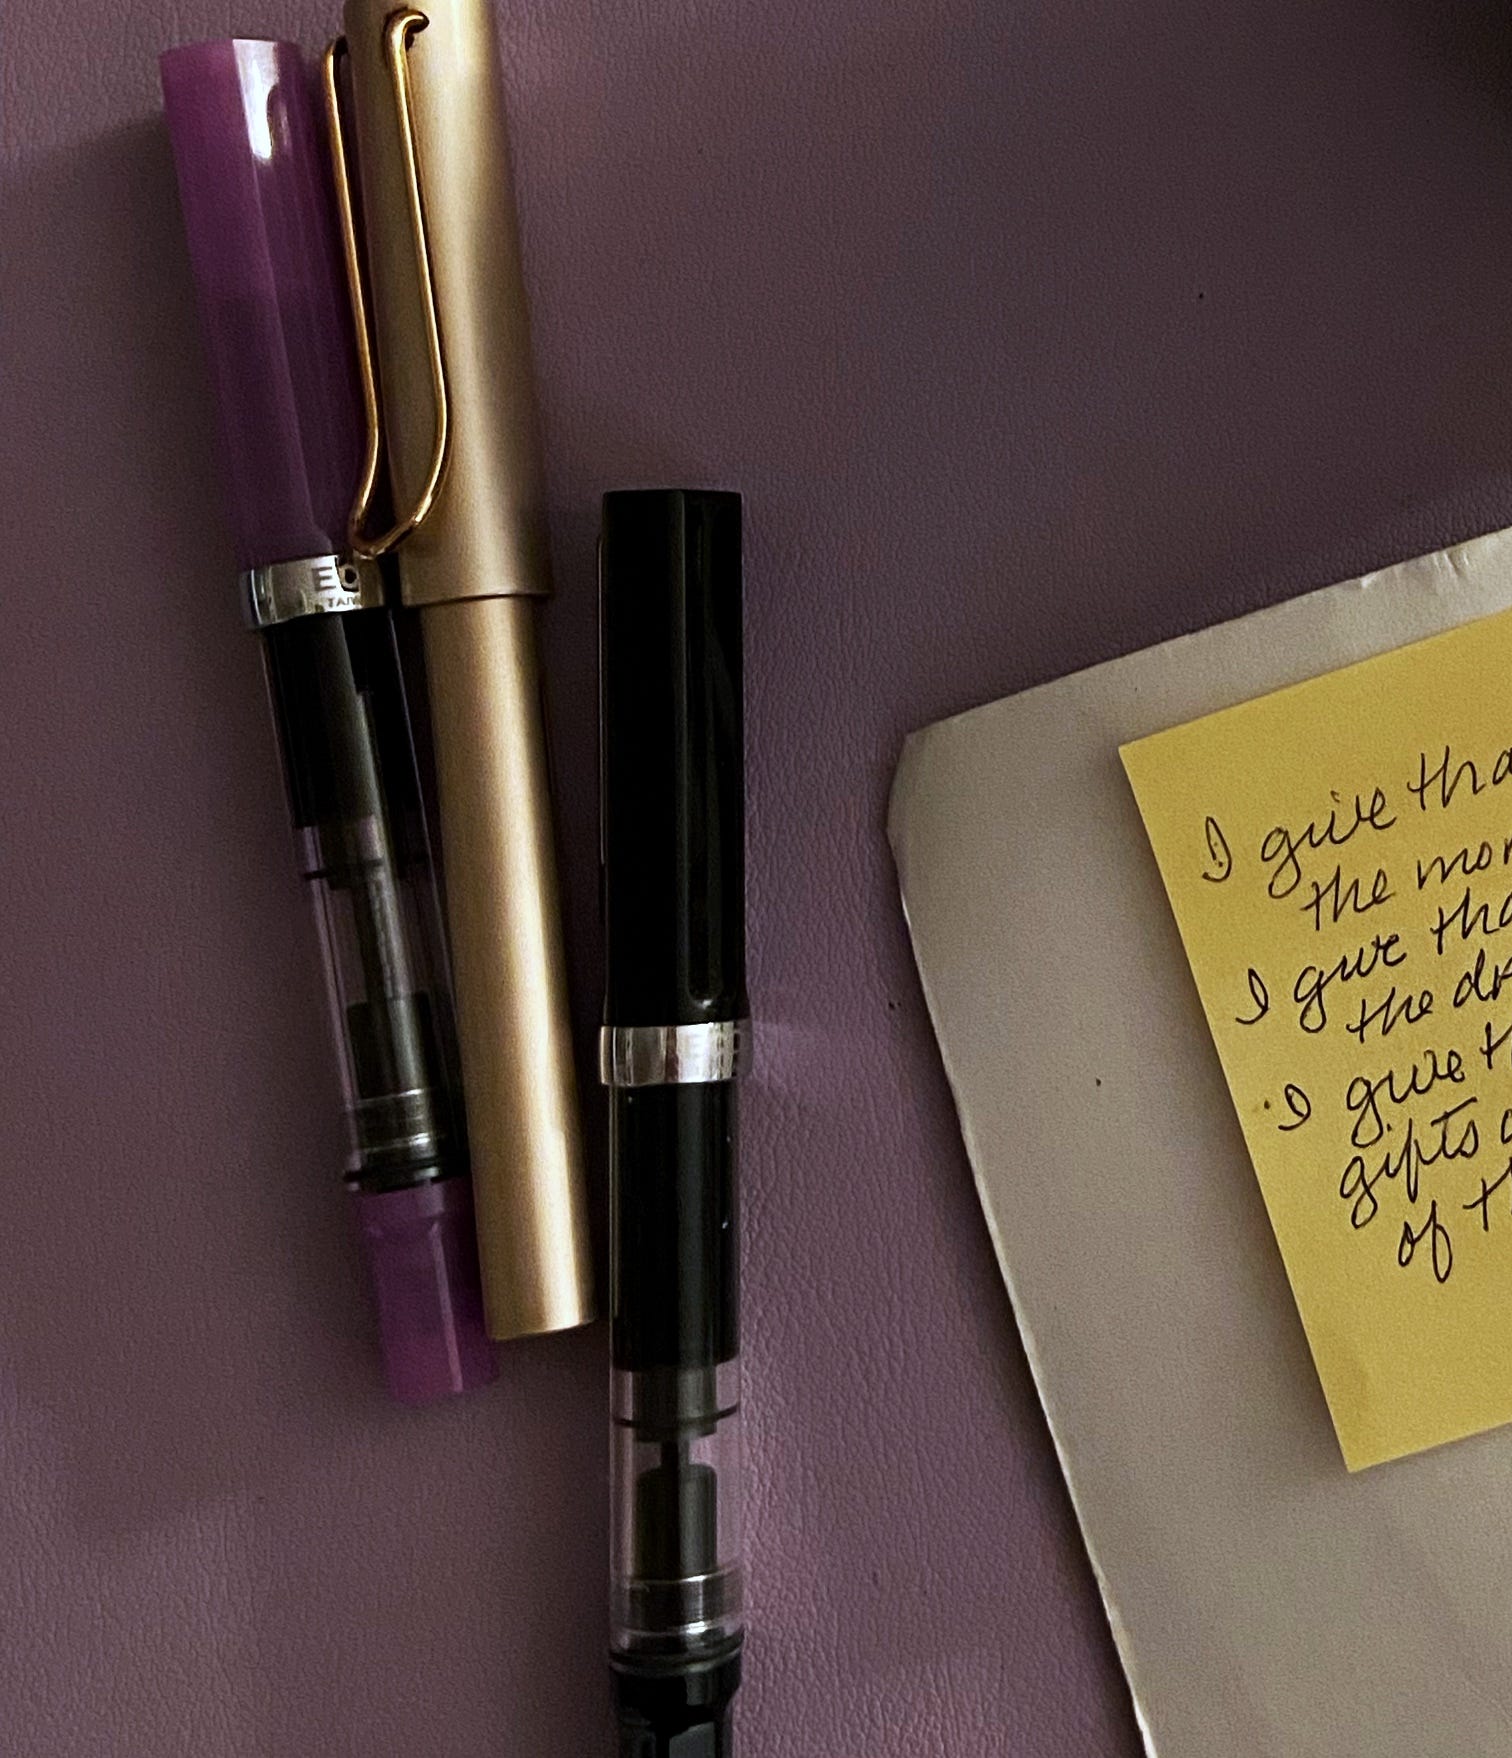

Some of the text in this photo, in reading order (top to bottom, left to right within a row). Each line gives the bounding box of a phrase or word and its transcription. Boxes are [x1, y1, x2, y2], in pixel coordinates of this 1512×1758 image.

[1262, 788, 1396, 898] give
[1301, 866, 1395, 931] the
[1235, 968, 1269, 1025] I
[1294, 934, 1407, 1033] give
[1346, 987, 1432, 1043] the
[1345, 1047, 1465, 1146] give
[1340, 1098, 1479, 1228] gifts
[1398, 1202, 1453, 1283] of
